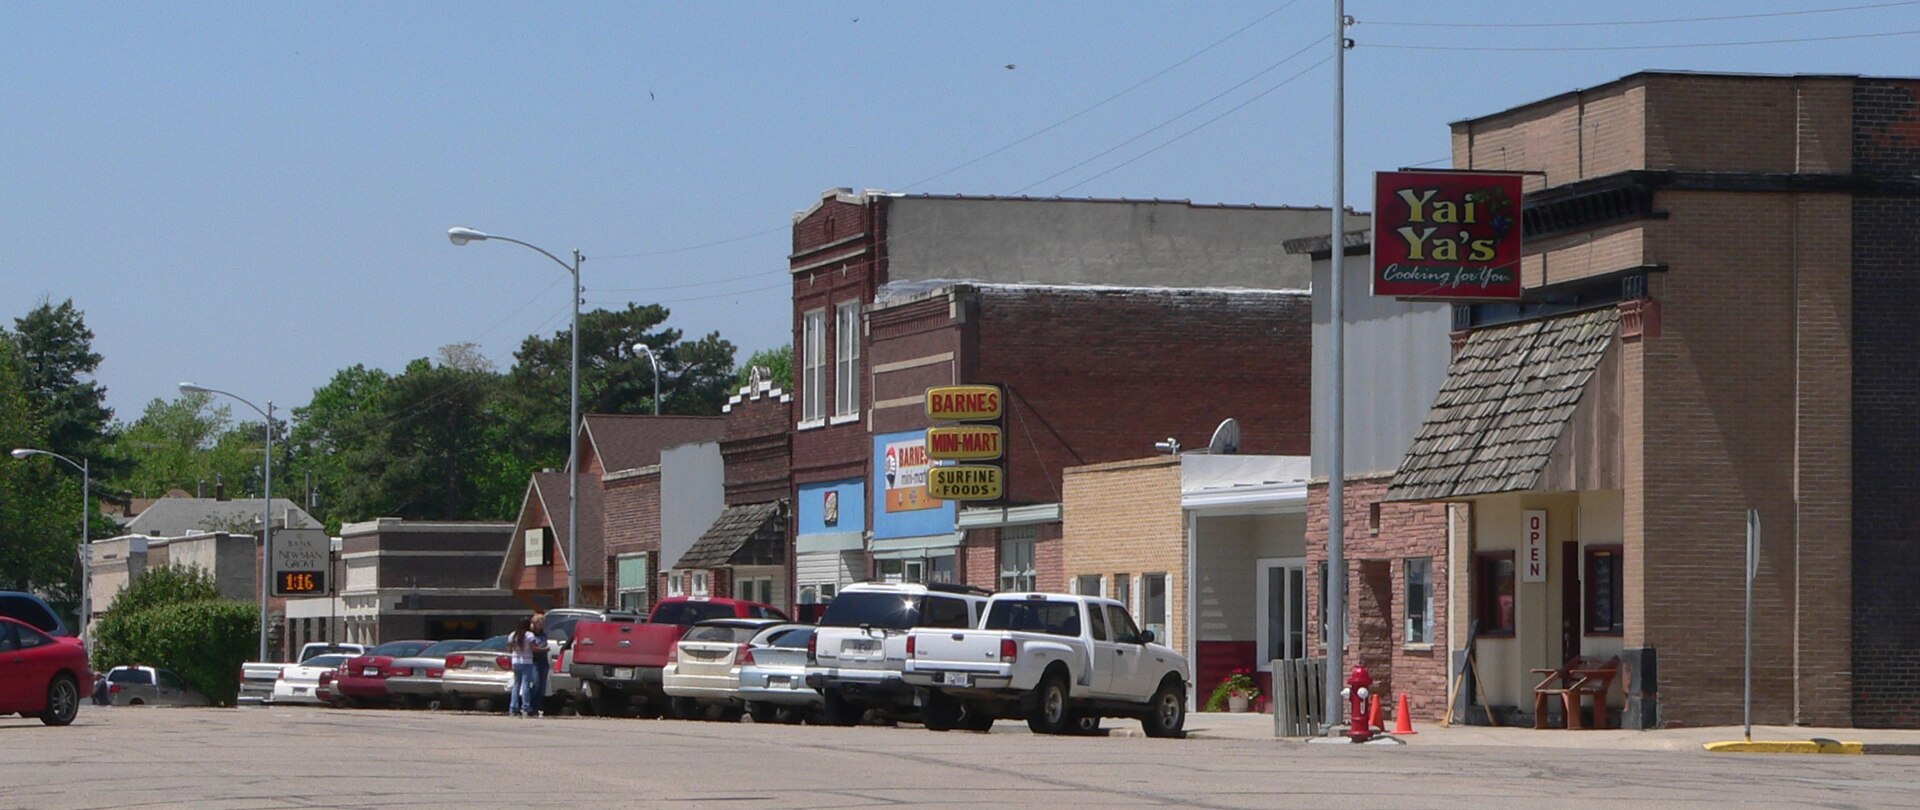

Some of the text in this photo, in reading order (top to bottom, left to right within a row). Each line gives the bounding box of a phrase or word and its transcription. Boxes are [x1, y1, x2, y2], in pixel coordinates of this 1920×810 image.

[1396, 189, 1477, 223] Yai
[1396, 226, 1496, 261] Ya's
[1383, 263, 1510, 289] Cooking for You
[931, 393, 998, 413] BARNES
[931, 432, 999, 453] MINI-MART
[938, 470, 995, 484] SURFINE
[943, 485, 989, 495] FOODS
[1530, 516, 1540, 577] OPEN
[286, 573, 314, 590] 1:16
